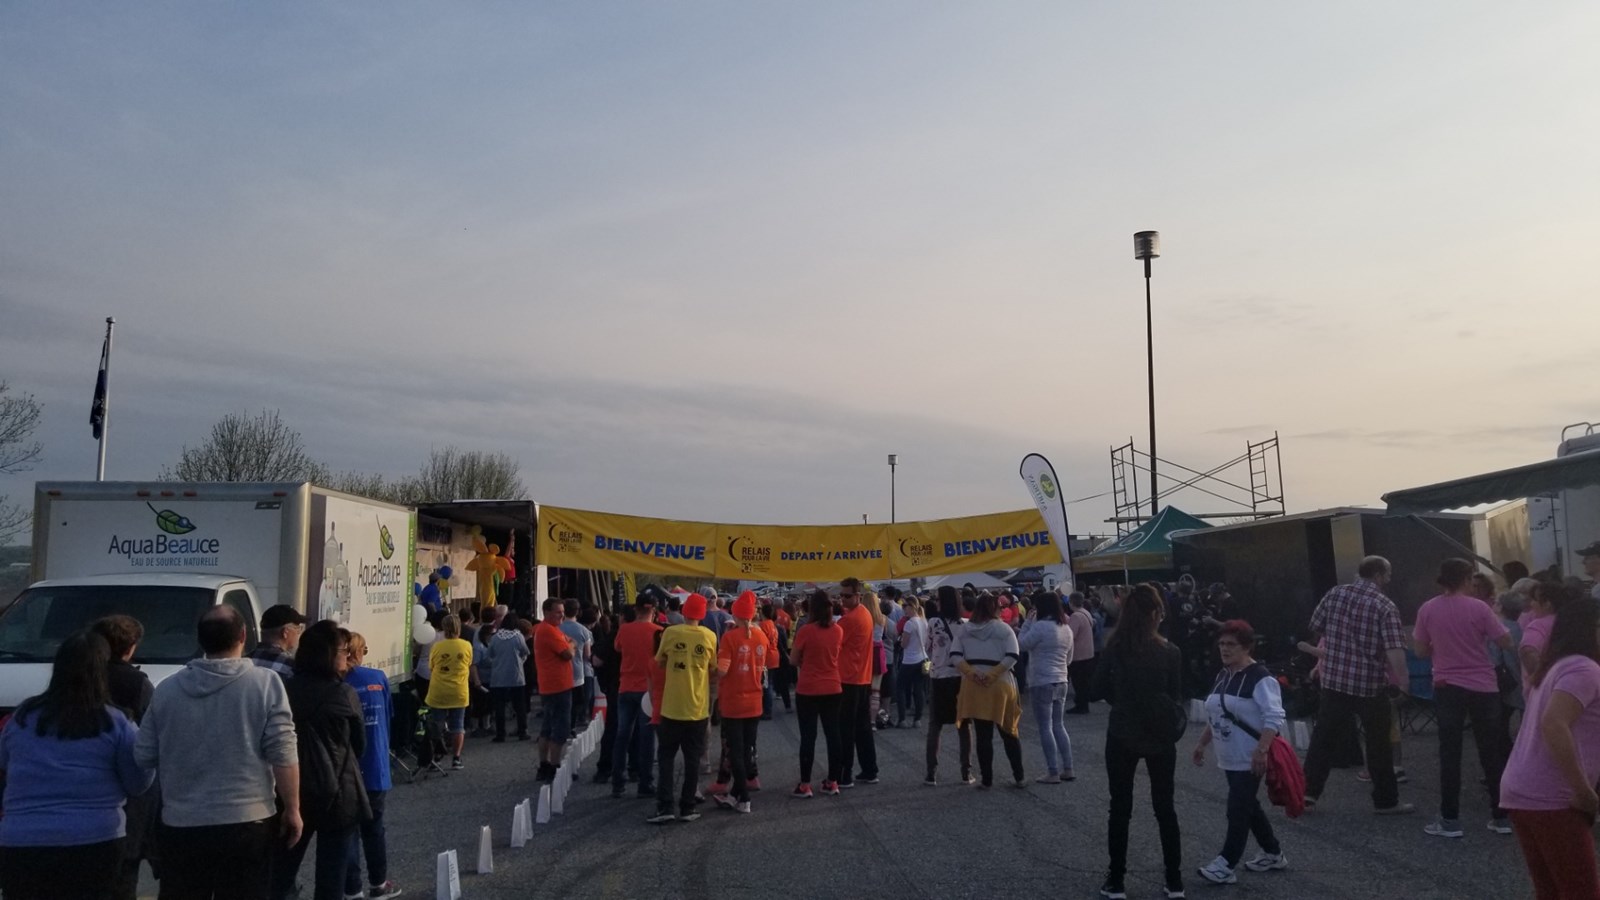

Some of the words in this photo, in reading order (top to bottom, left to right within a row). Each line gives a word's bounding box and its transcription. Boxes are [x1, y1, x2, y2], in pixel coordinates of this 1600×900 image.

[108, 534, 219, 559] AquaBeauce
[594, 535, 706, 560] BIENVENUE
[741, 546, 771, 556] RELAIS
[826, 551, 832, 561] /
[944, 531, 1050, 557] BIENVENUE
[131, 557, 144, 567] EAU
[145, 557, 154, 567] DE
[156, 557, 182, 567] SOURCE
[183, 557, 219, 567] NATURELLE
[357, 557, 401, 594] AquaBeauce
